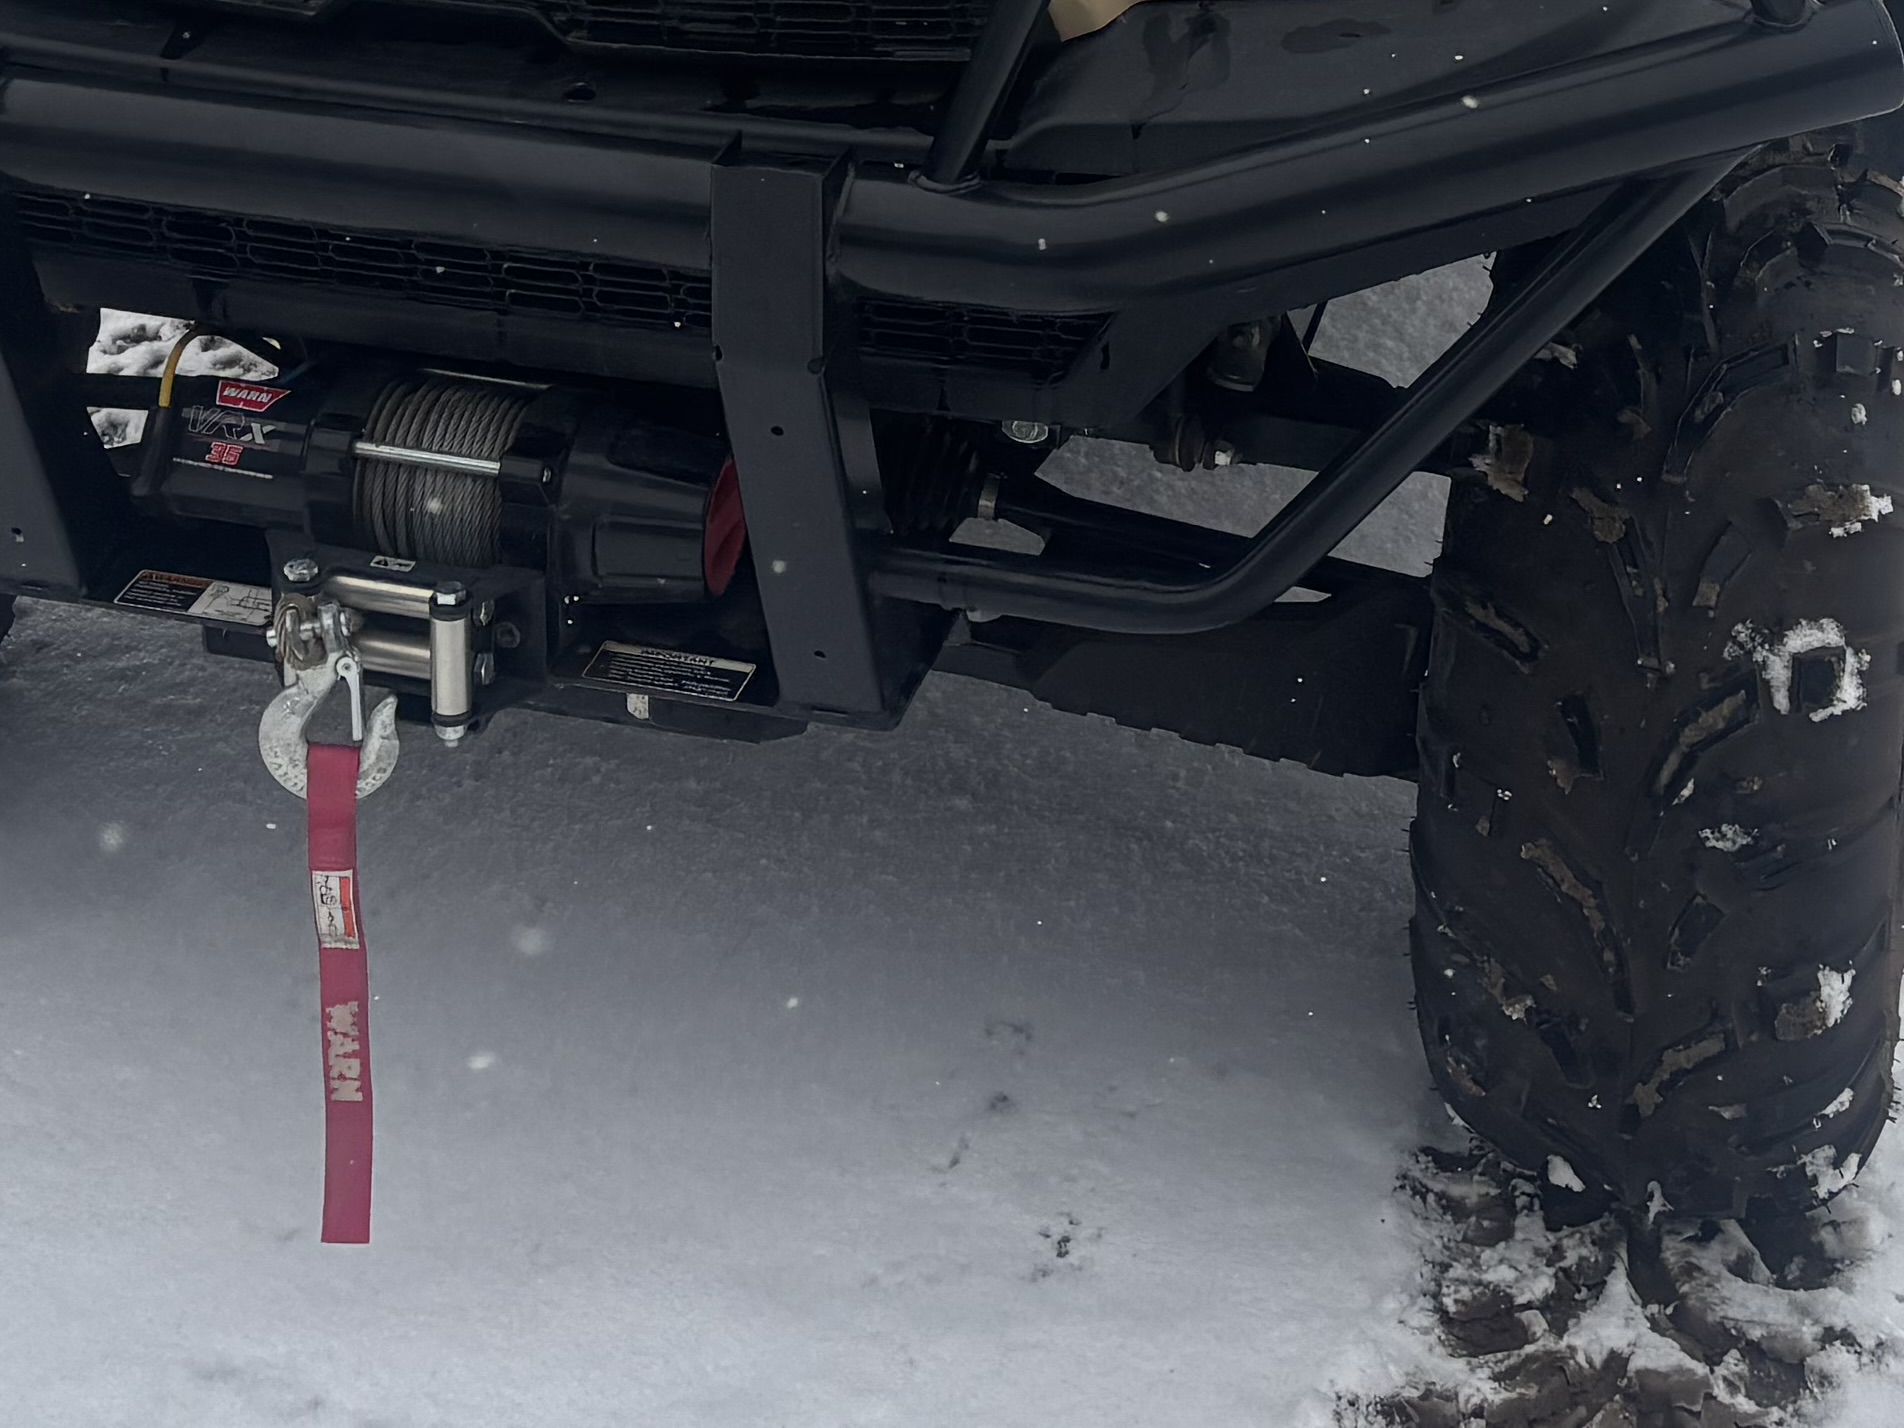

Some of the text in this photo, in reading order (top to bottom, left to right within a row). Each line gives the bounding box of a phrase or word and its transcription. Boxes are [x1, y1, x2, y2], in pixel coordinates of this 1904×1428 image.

[222, 386, 273, 403] WARN
[205, 441, 244, 465] 35
[326, 1001, 364, 1101] WARN
